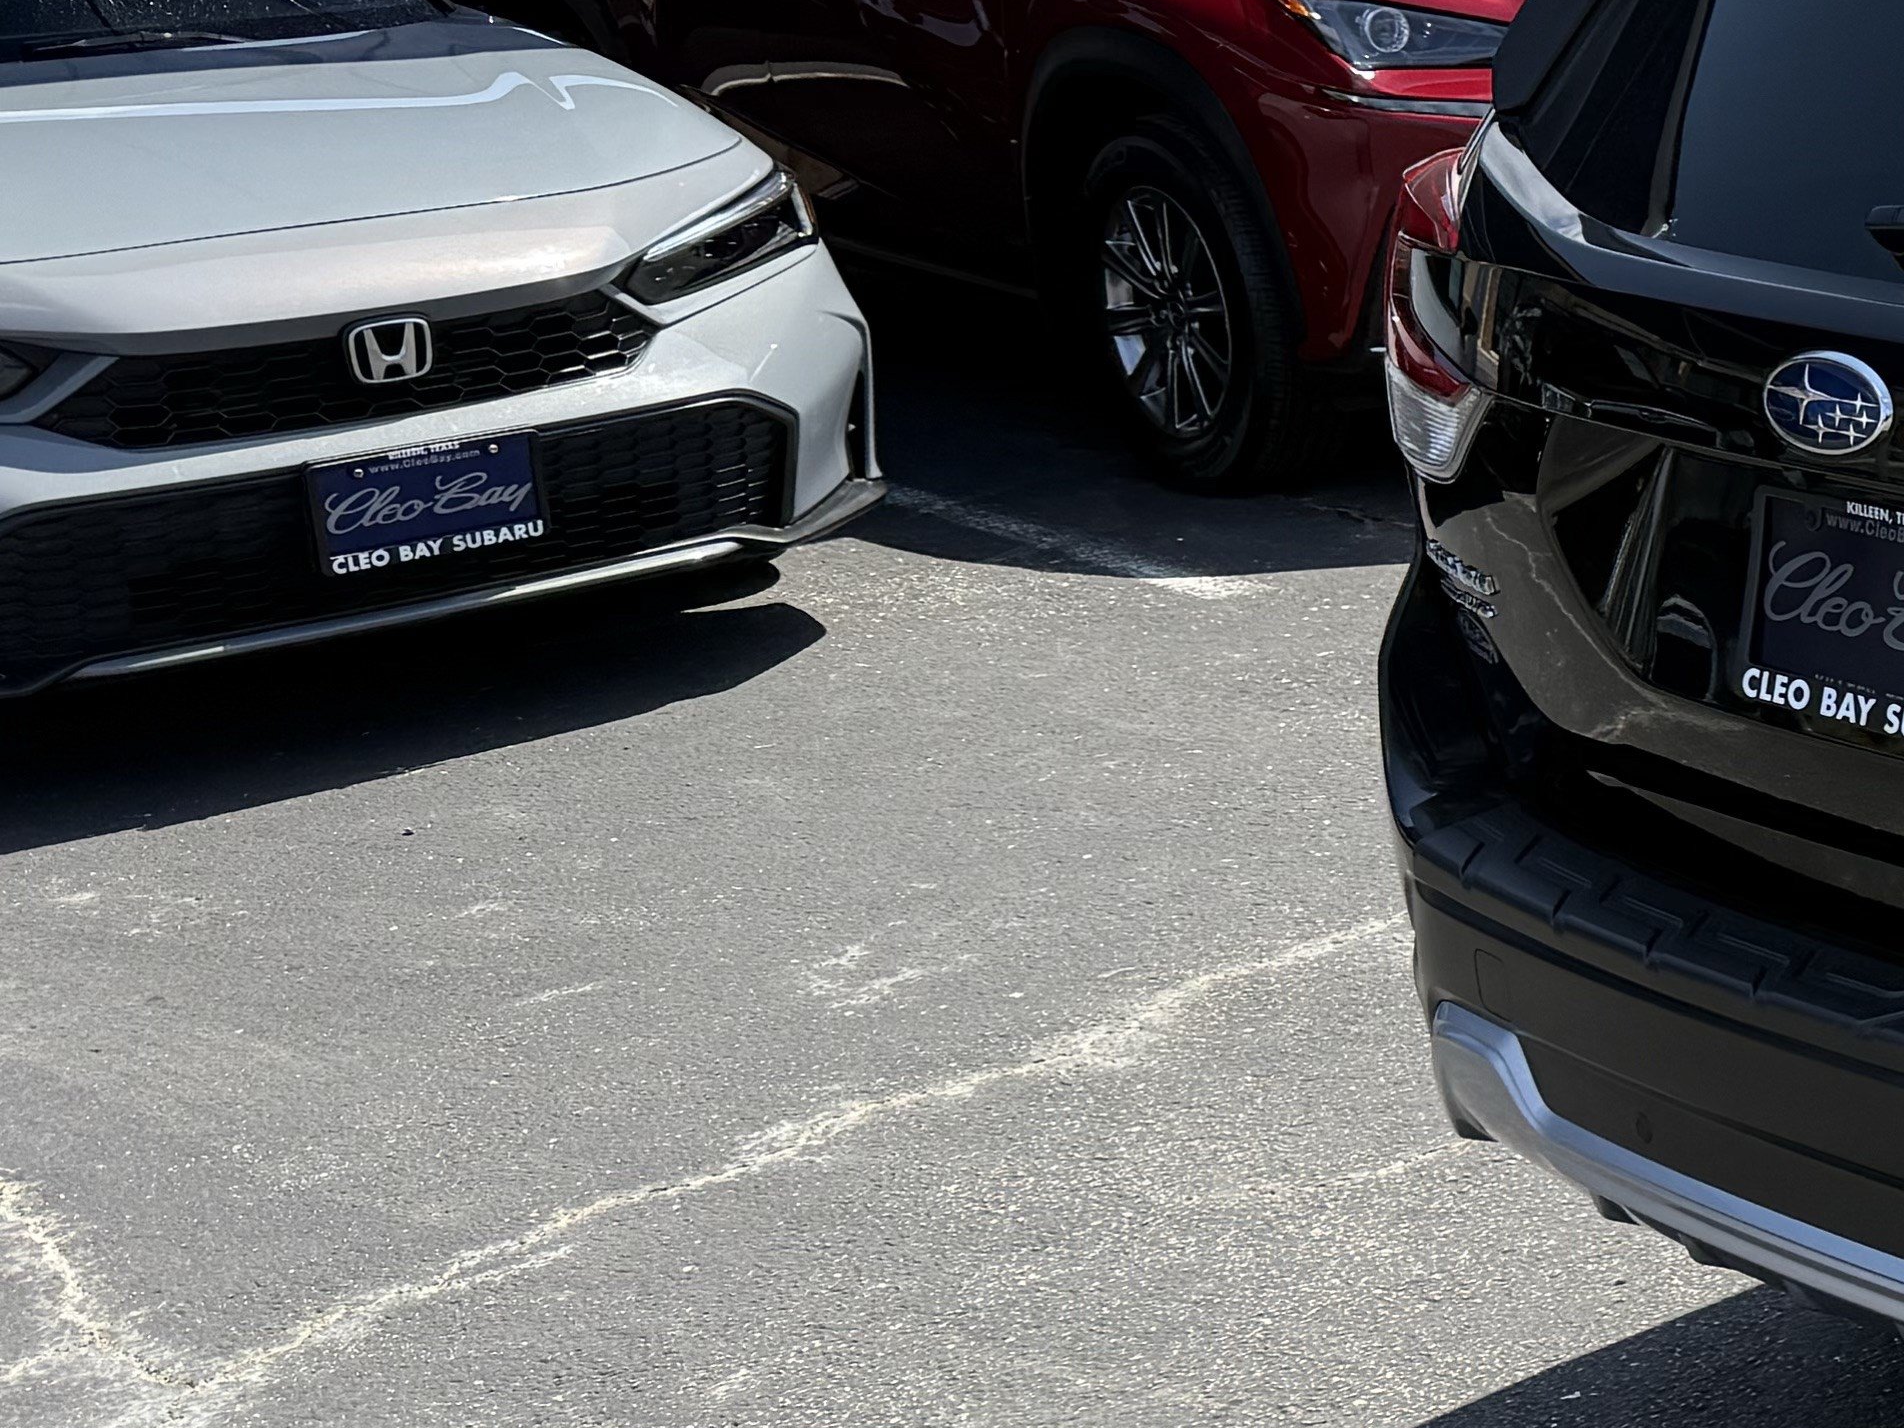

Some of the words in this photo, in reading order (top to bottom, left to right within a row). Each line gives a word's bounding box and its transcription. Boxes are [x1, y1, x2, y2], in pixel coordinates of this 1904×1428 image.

[325, 486, 434, 535] Cleo
[433, 472, 533, 512] Bay
[1846, 501, 1893, 524] KILLEEN,
[331, 548, 391, 574] CLEO
[399, 538, 443, 562] BAY
[452, 519, 545, 552] SUBARU
[1763, 540, 1886, 637] Cleo
[1741, 667, 1811, 710] CLEO
[1819, 686, 1877, 726] BAY
